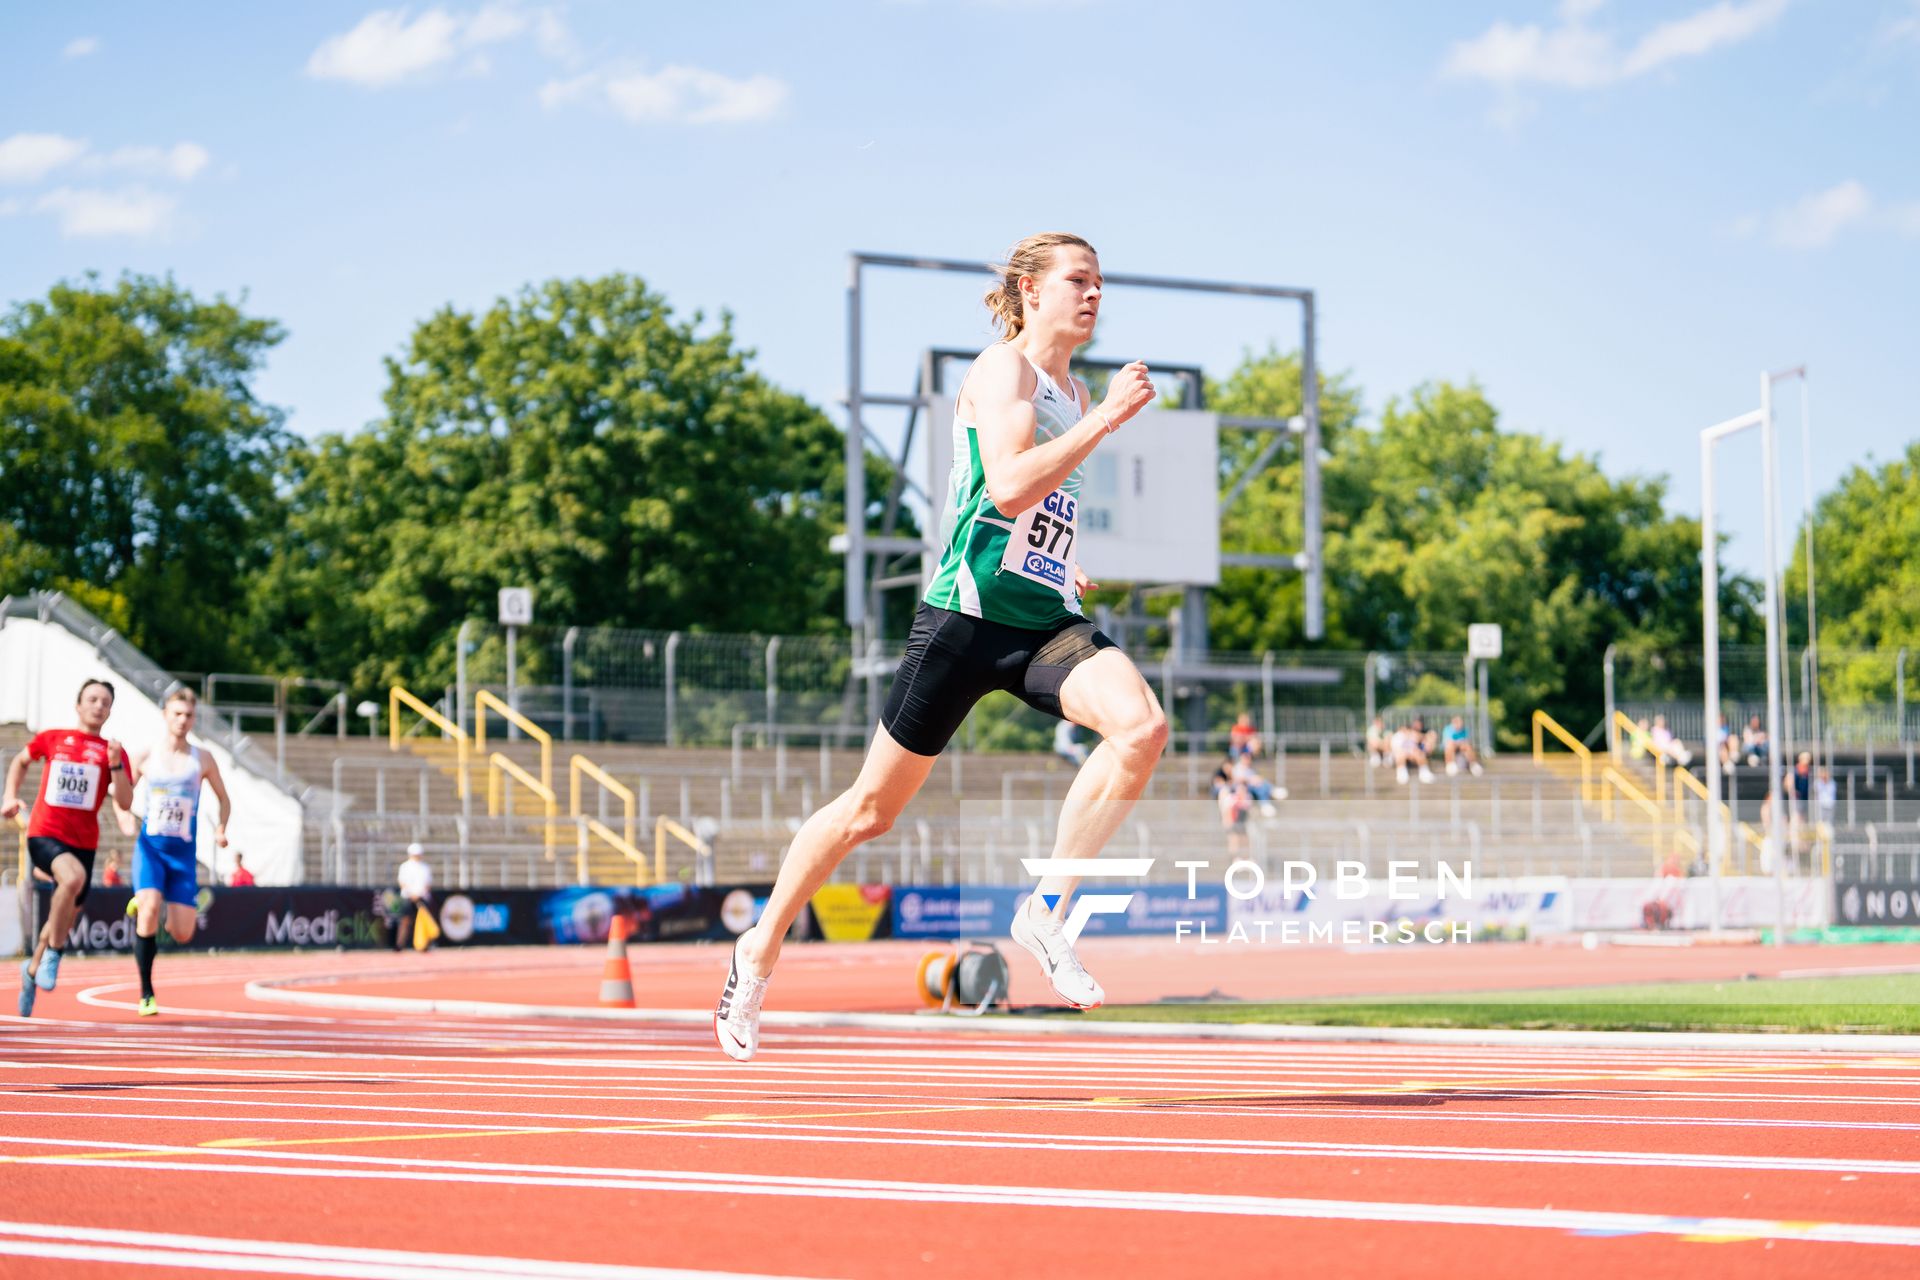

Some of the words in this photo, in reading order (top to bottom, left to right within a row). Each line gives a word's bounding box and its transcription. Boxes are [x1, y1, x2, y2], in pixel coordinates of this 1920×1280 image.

[1043, 491, 1075, 522] GLS
[1027, 512, 1074, 560] 577
[1044, 561, 1065, 579] PLAN
[57, 776, 89, 793] 908
